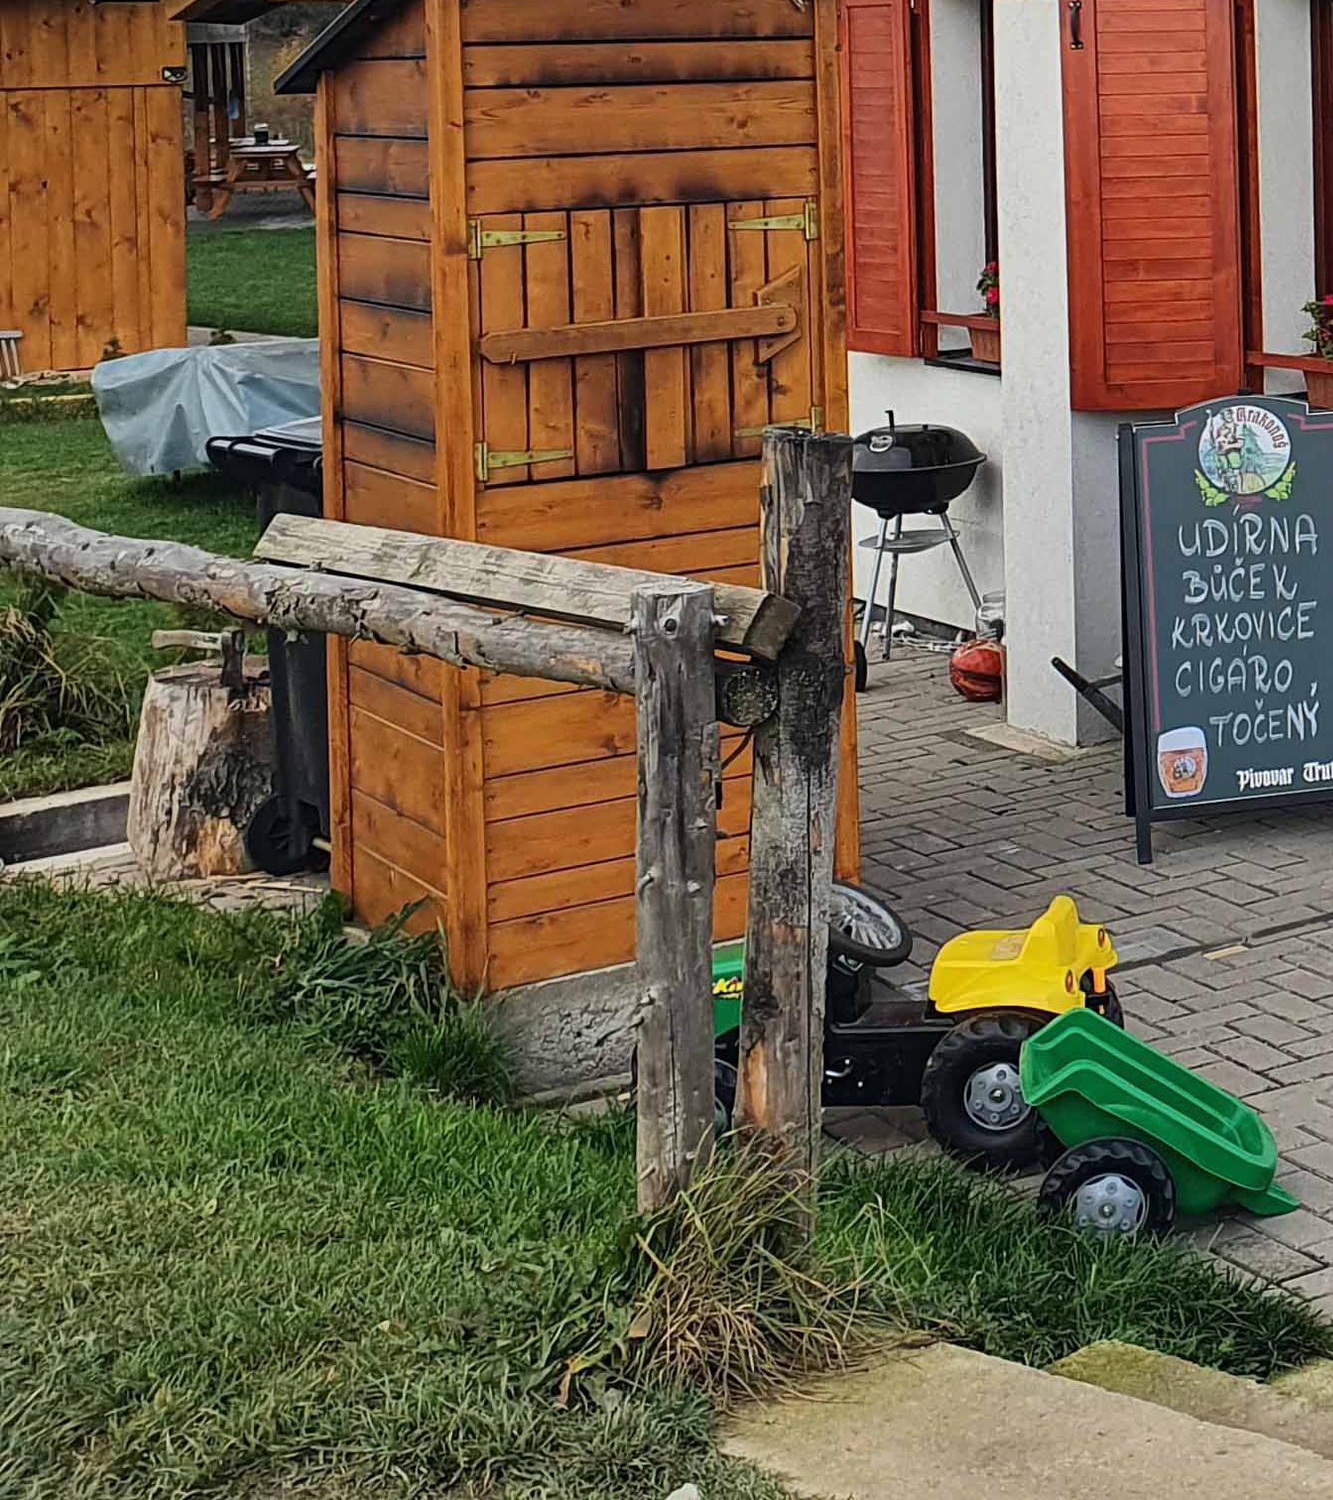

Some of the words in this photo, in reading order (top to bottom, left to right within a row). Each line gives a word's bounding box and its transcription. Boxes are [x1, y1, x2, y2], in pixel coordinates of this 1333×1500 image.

[1178, 503, 1318, 557] UDÍRNA
[1182, 557, 1298, 604] BŮČEK
[1171, 601, 1317, 649] KRKOVICE
[1175, 644, 1293, 698] CIGÁRO
[1208, 682, 1320, 747] TOČENÝ
[1236, 768, 1294, 792] Pivovar
